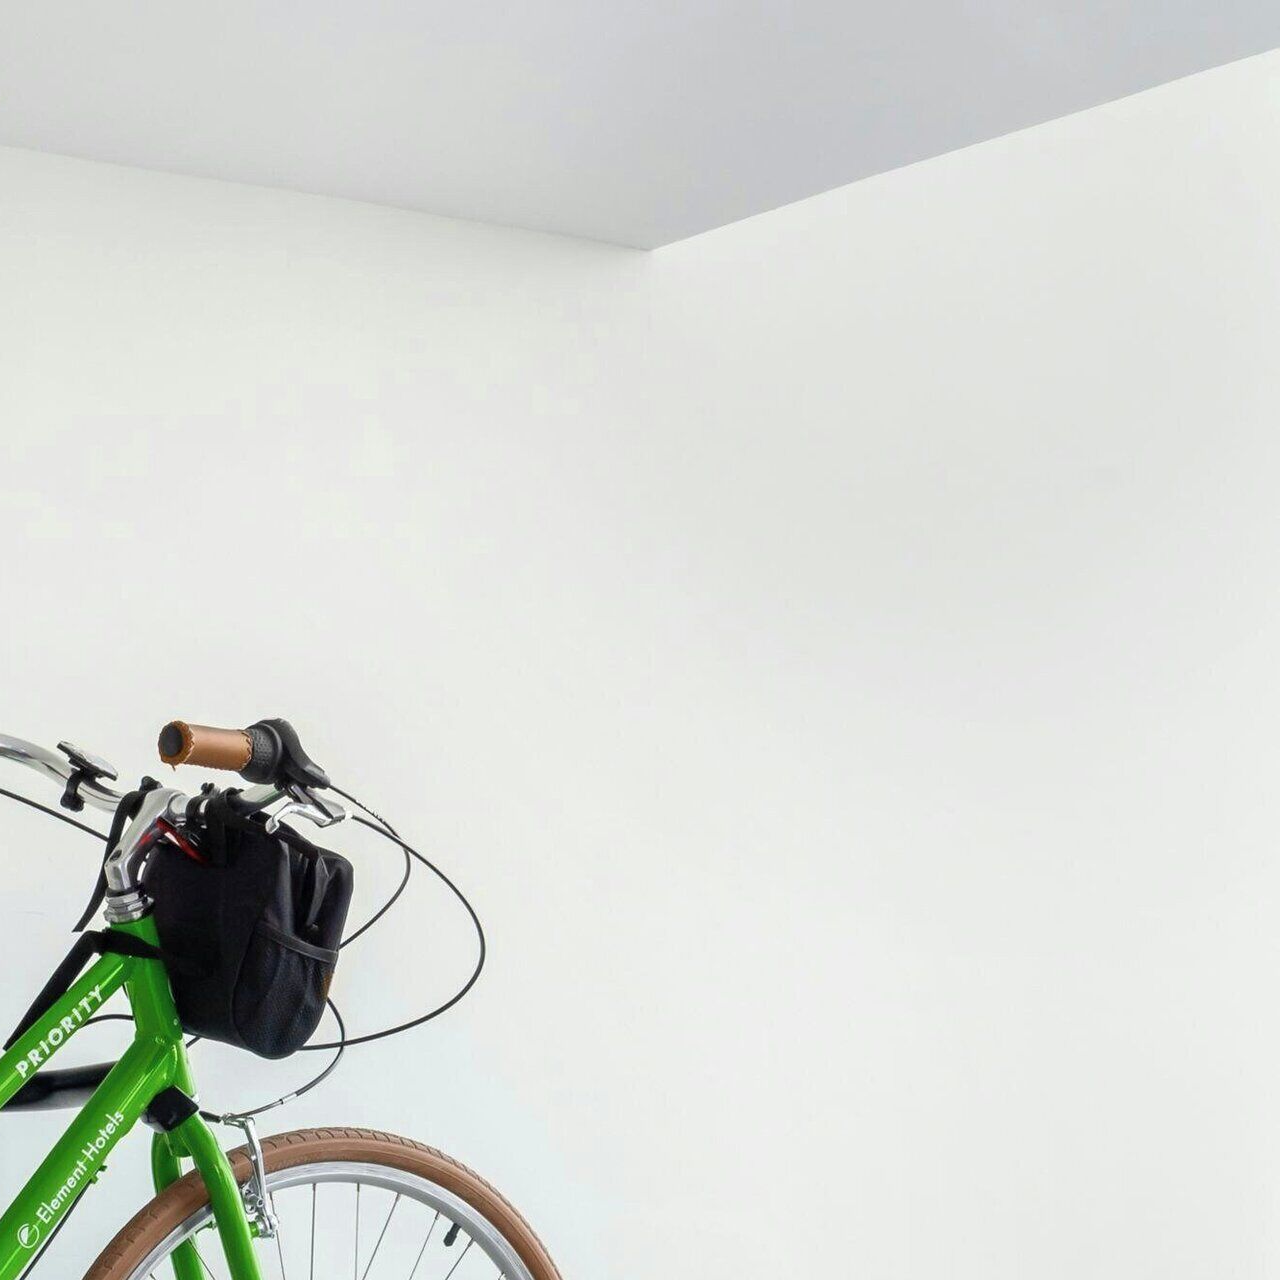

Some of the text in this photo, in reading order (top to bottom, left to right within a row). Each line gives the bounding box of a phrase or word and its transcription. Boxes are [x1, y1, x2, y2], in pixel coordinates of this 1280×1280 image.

[15, 984, 104, 1080] PRIORITY
[35, 1110, 125, 1224] Element Hotels
